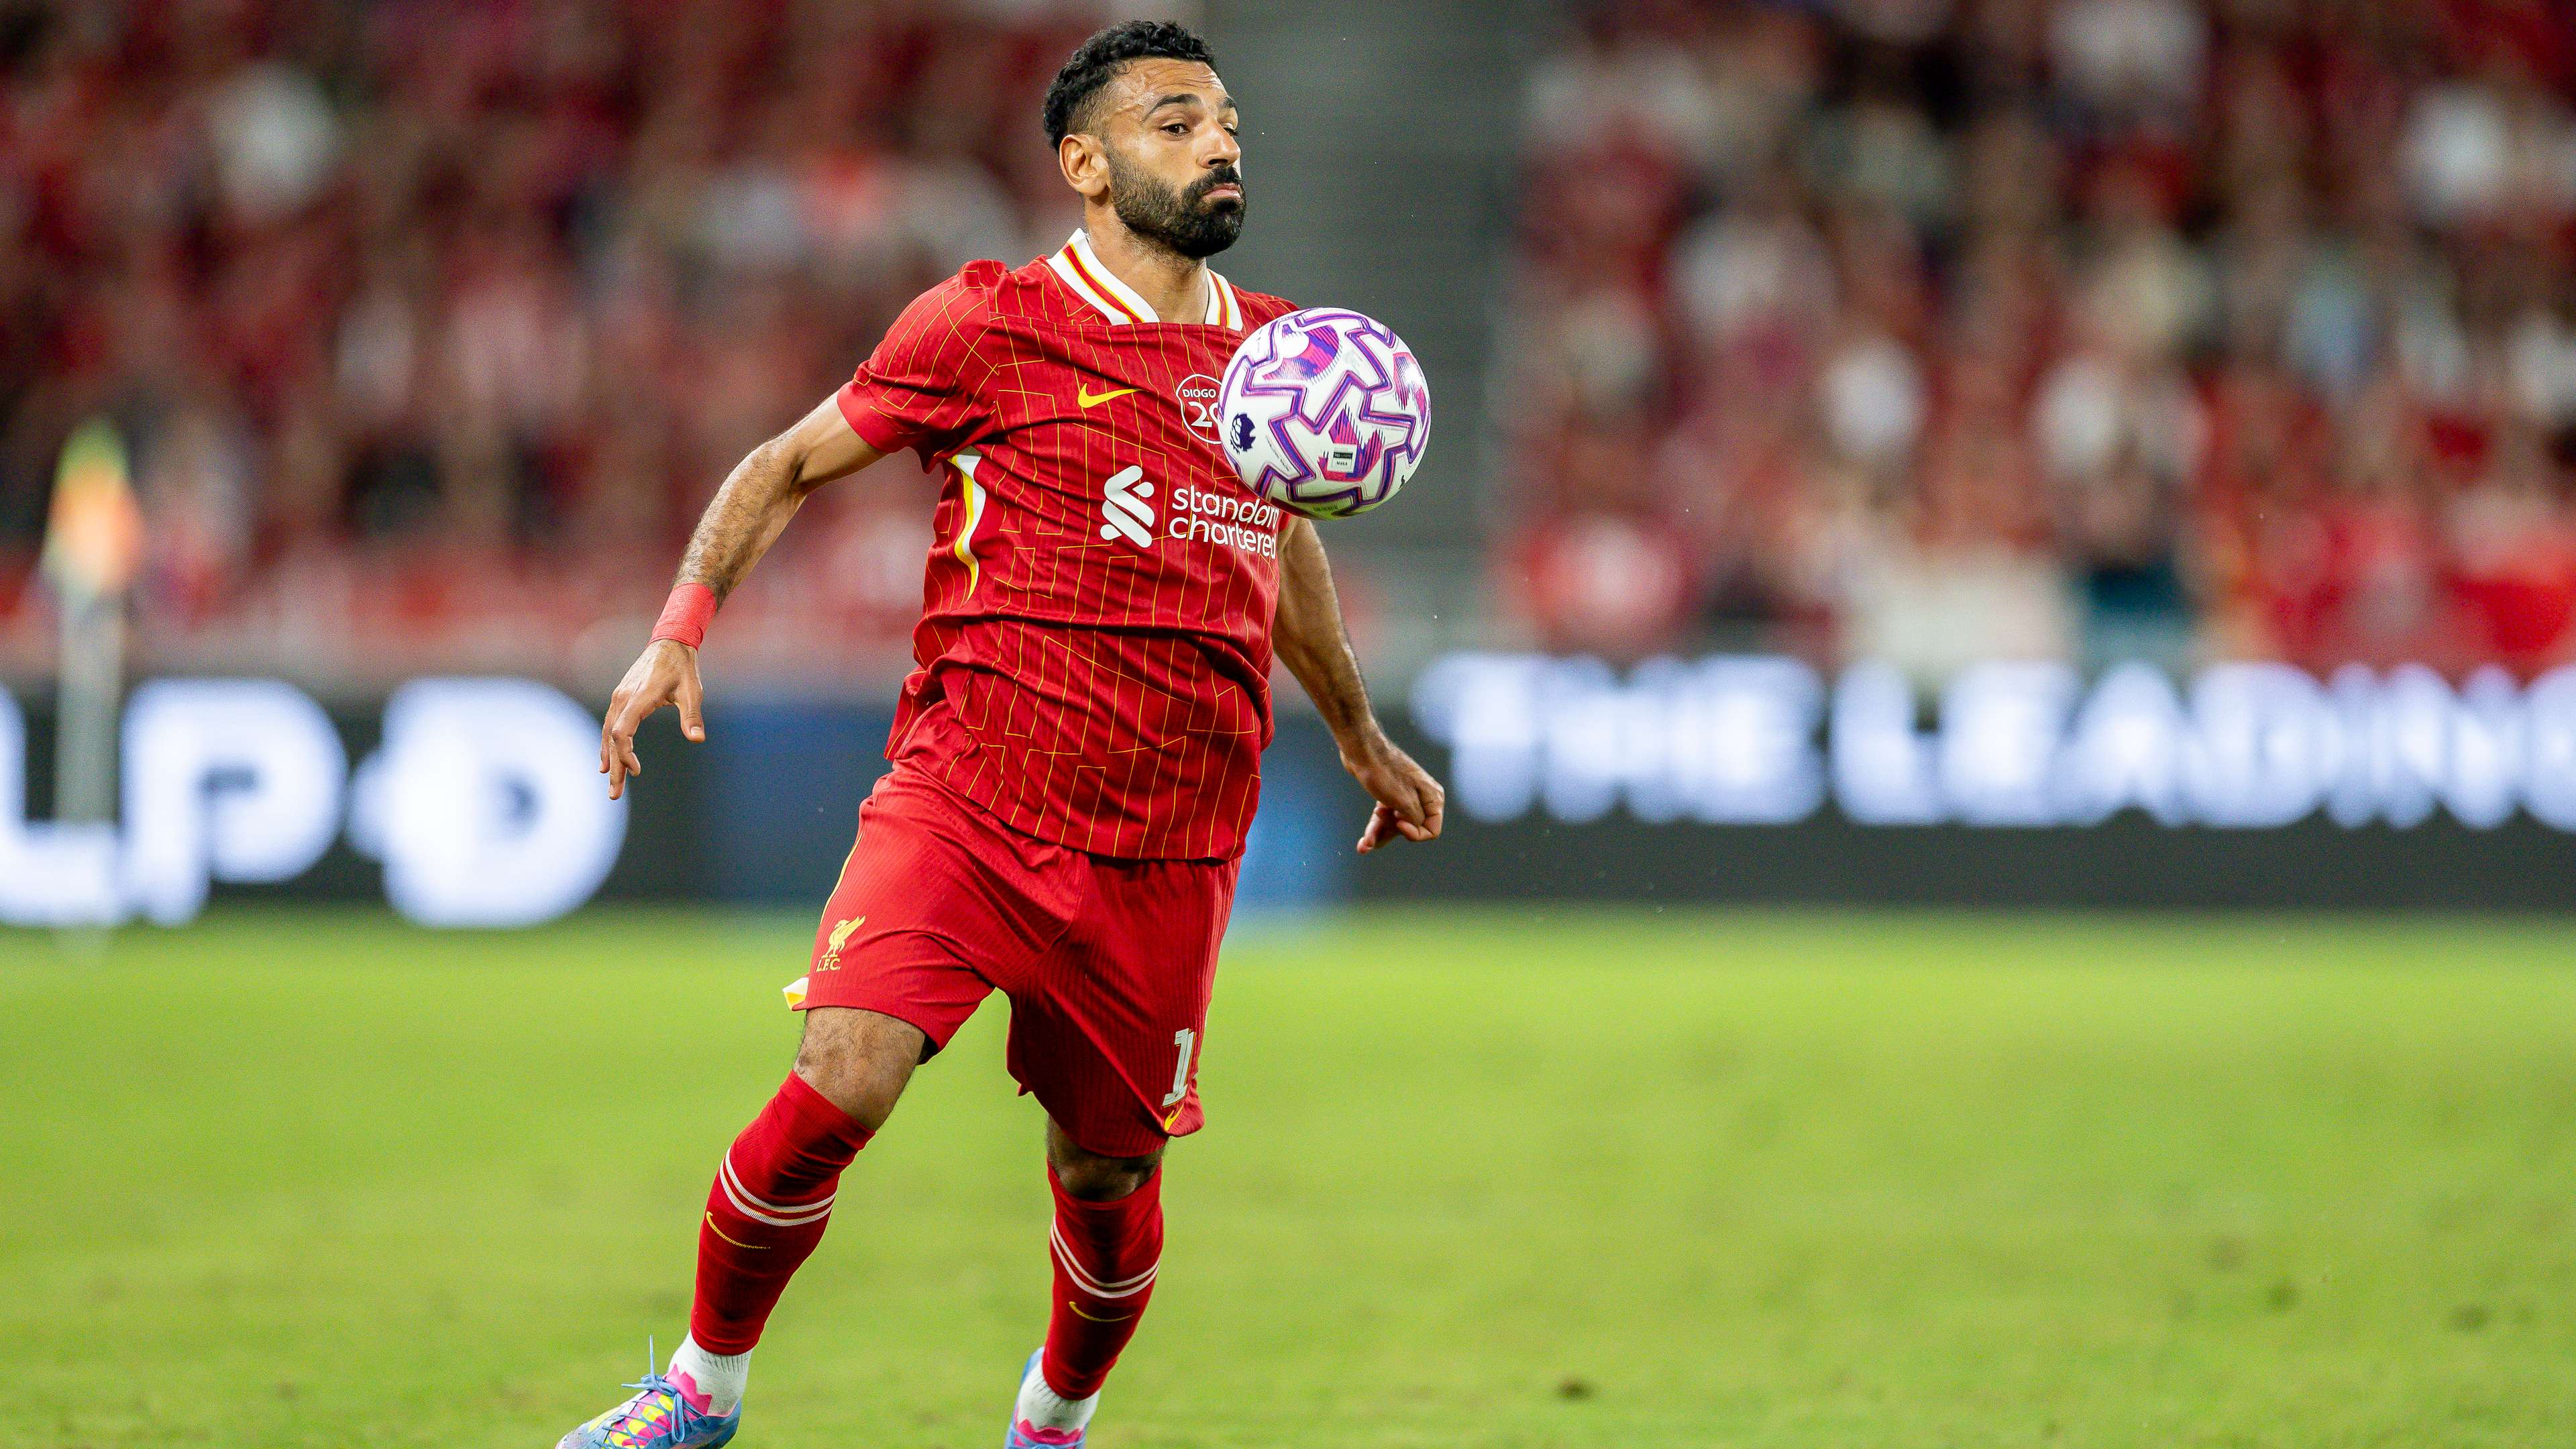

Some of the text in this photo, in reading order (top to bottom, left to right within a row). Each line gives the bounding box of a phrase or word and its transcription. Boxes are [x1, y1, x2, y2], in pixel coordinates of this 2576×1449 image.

[1182, 388, 1217, 398] DIOGO
[1169, 514, 1277, 559] chartered
[1414, 654, 1826, 824] THE
